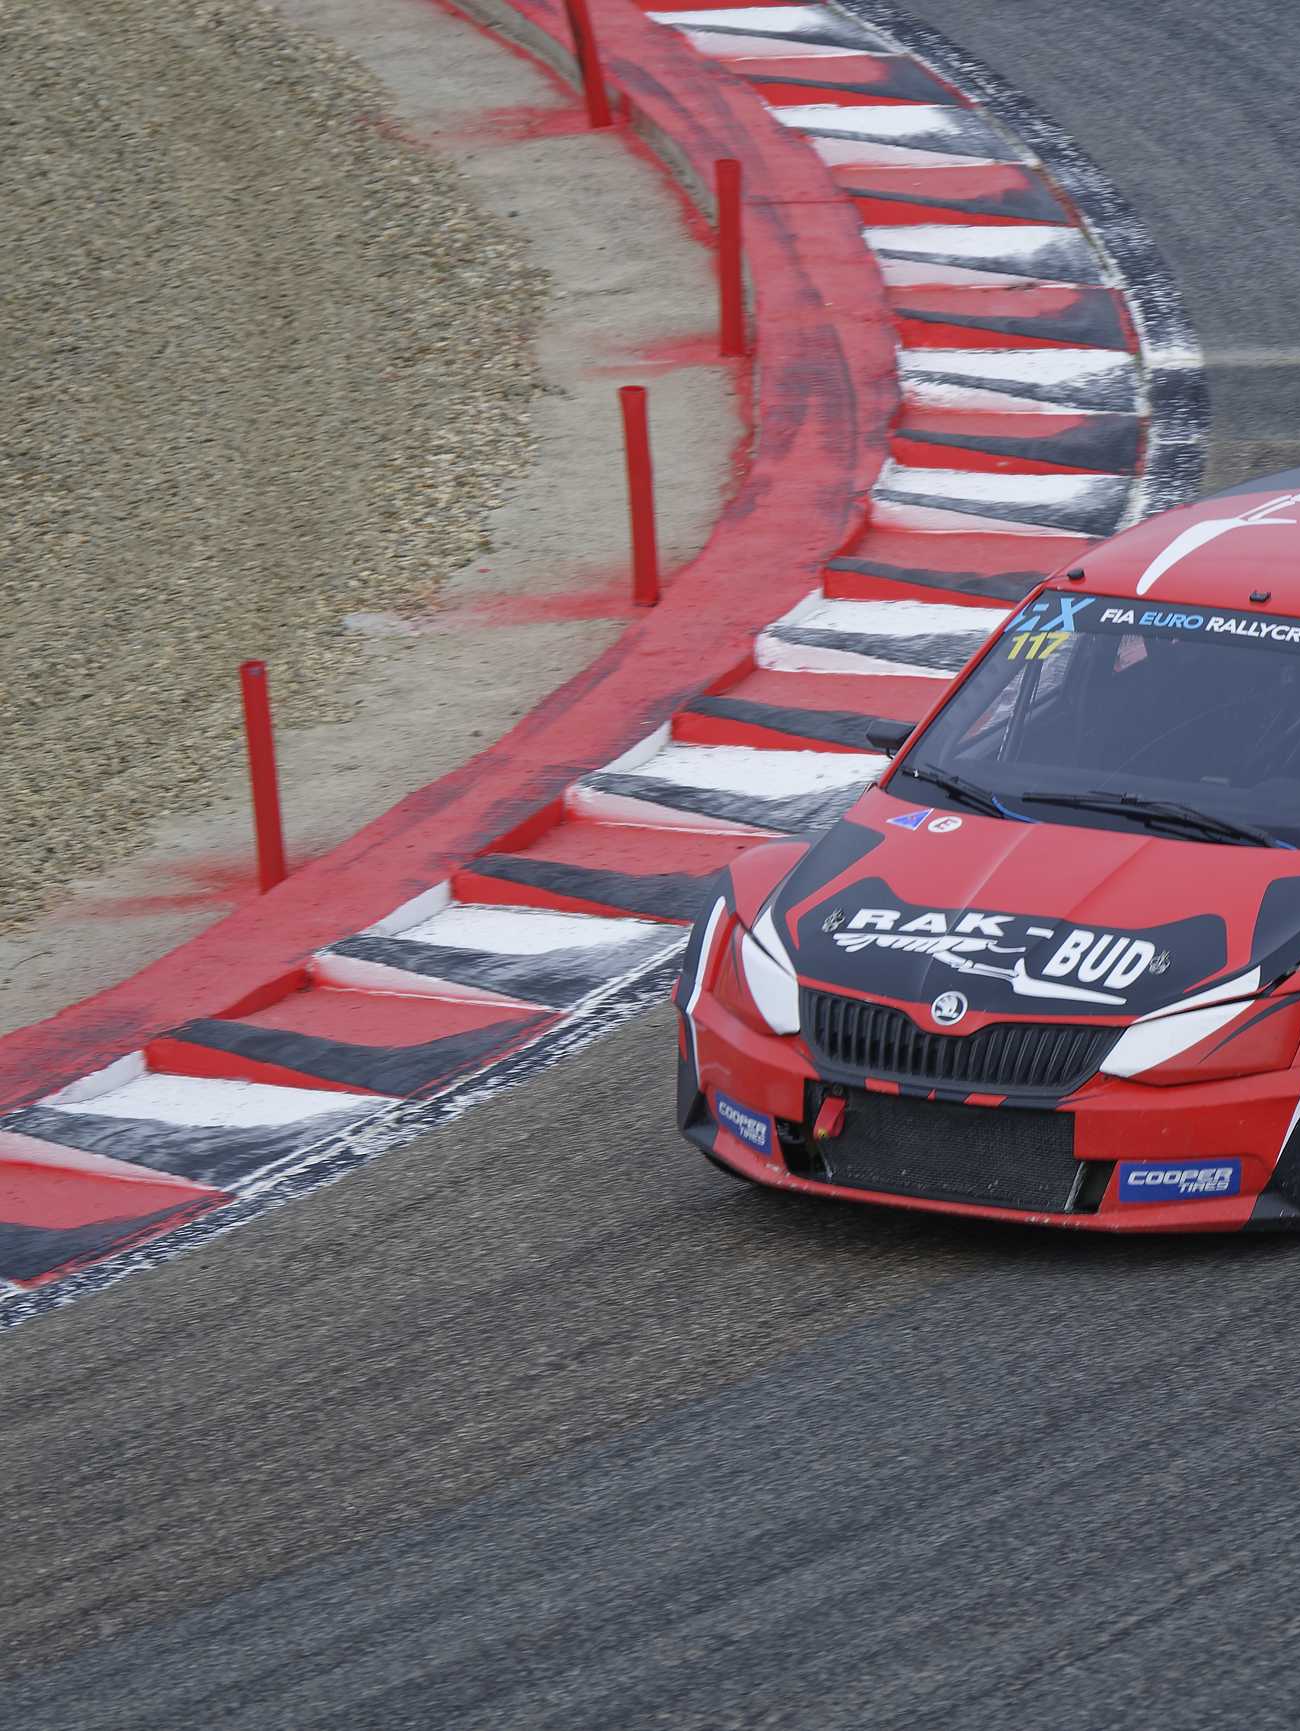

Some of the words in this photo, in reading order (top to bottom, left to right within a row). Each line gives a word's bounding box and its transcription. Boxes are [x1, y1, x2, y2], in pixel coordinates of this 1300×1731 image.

[1100, 608, 1134, 625] FIA
[1139, 611, 1204, 630] EURO
[1007, 631, 1071, 660] 117
[719, 1101, 767, 1137] COOPER
[1127, 1167, 1233, 1186] COOPER
[1180, 1182, 1229, 1193] TIRES
